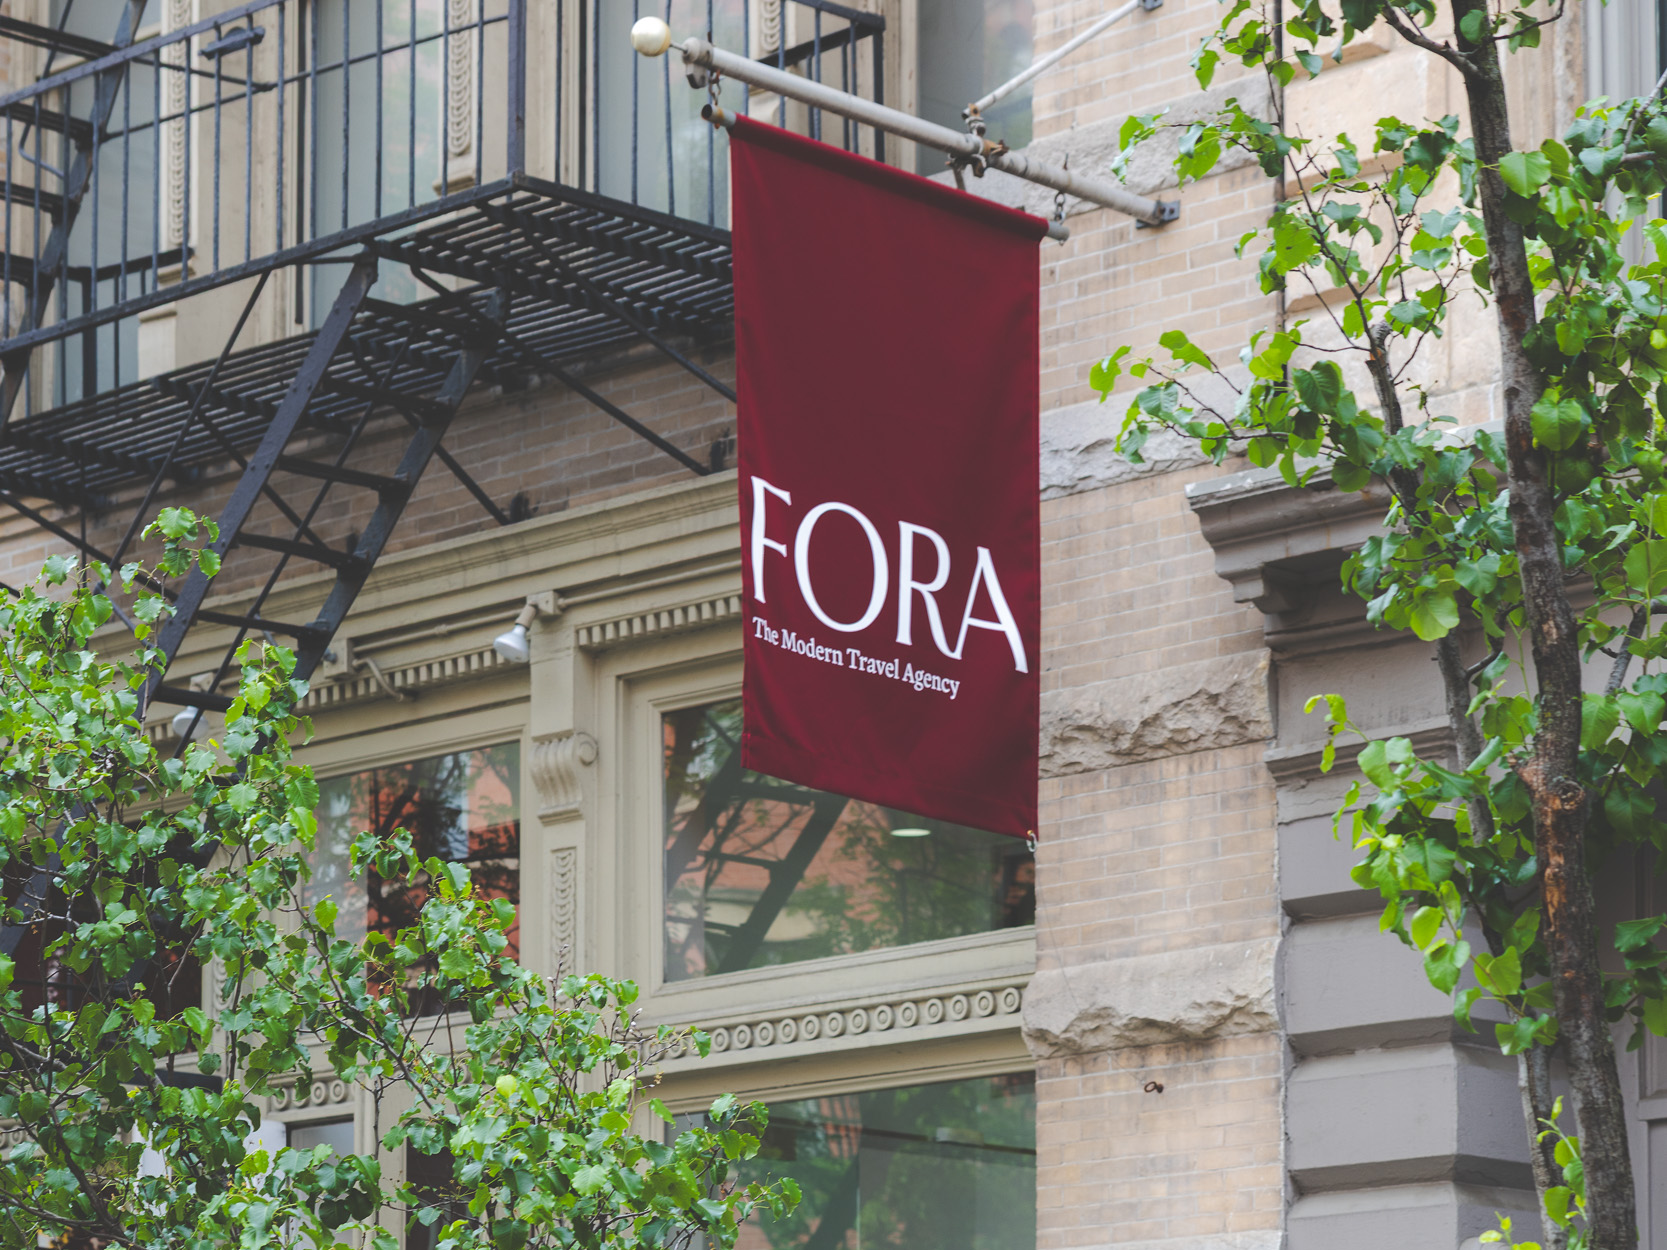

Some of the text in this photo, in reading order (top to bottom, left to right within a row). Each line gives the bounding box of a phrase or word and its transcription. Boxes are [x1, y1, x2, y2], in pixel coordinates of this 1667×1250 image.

[751, 475, 1028, 674] FORA
[752, 616, 960, 700] The Modern Travel Agency
